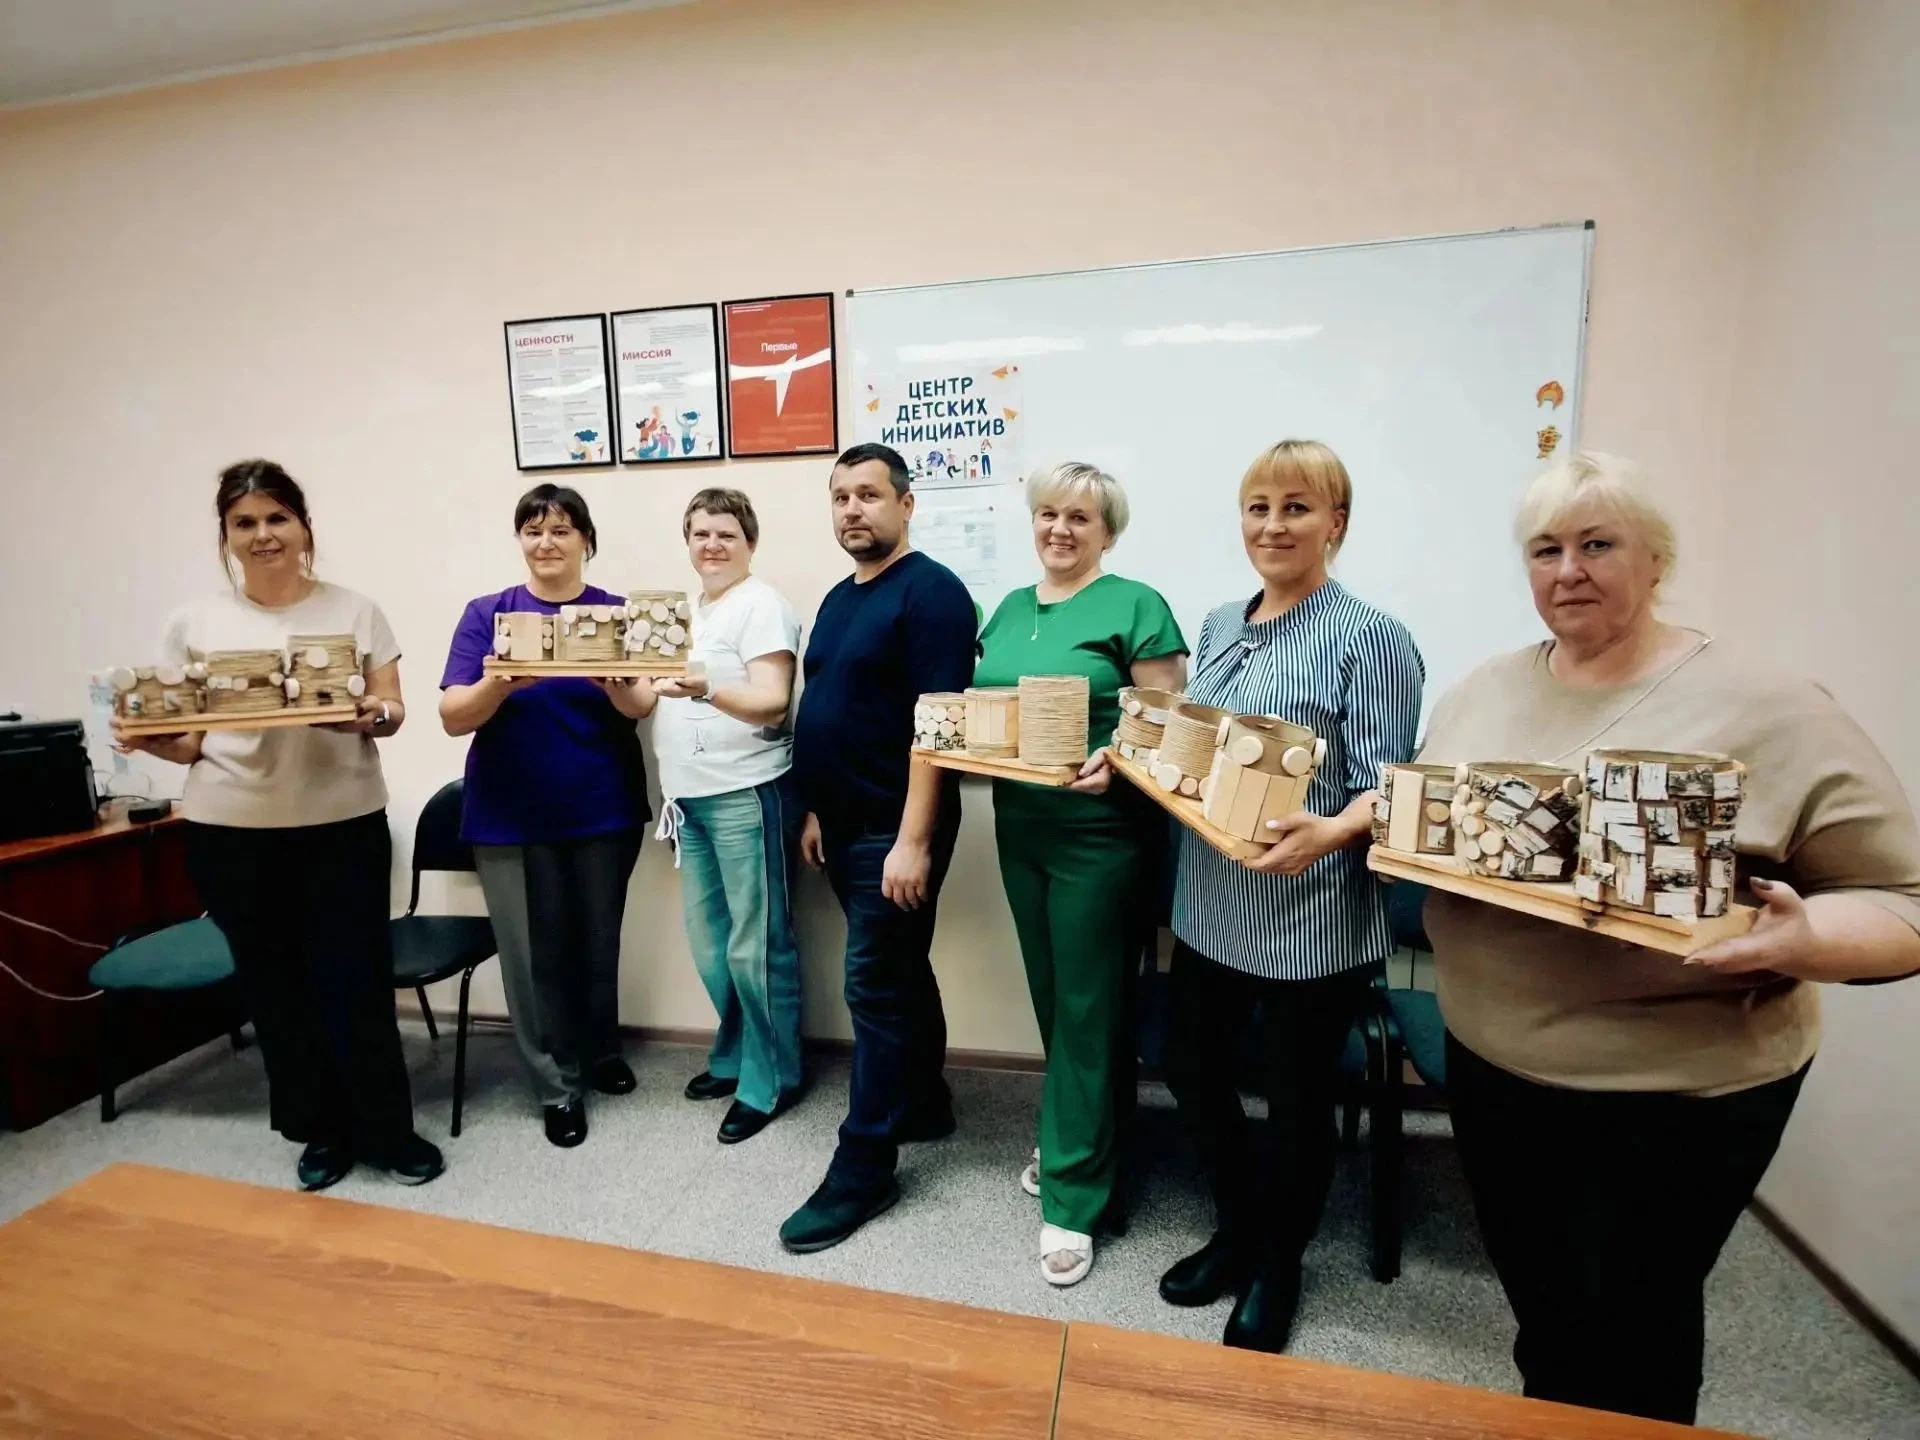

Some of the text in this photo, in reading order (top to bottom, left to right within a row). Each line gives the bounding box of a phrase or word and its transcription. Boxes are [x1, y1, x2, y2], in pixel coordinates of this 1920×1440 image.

[515, 334, 574, 347] ЦЕННОСТИ
[761, 342, 798, 354] Первые
[622, 348, 672, 360] МИССИЯ
[908, 377, 973, 400] ЦЕНТР
[896, 398, 988, 424] ДЕТСКИХ
[882, 419, 1005, 444] ИНИЦИАТИВ
